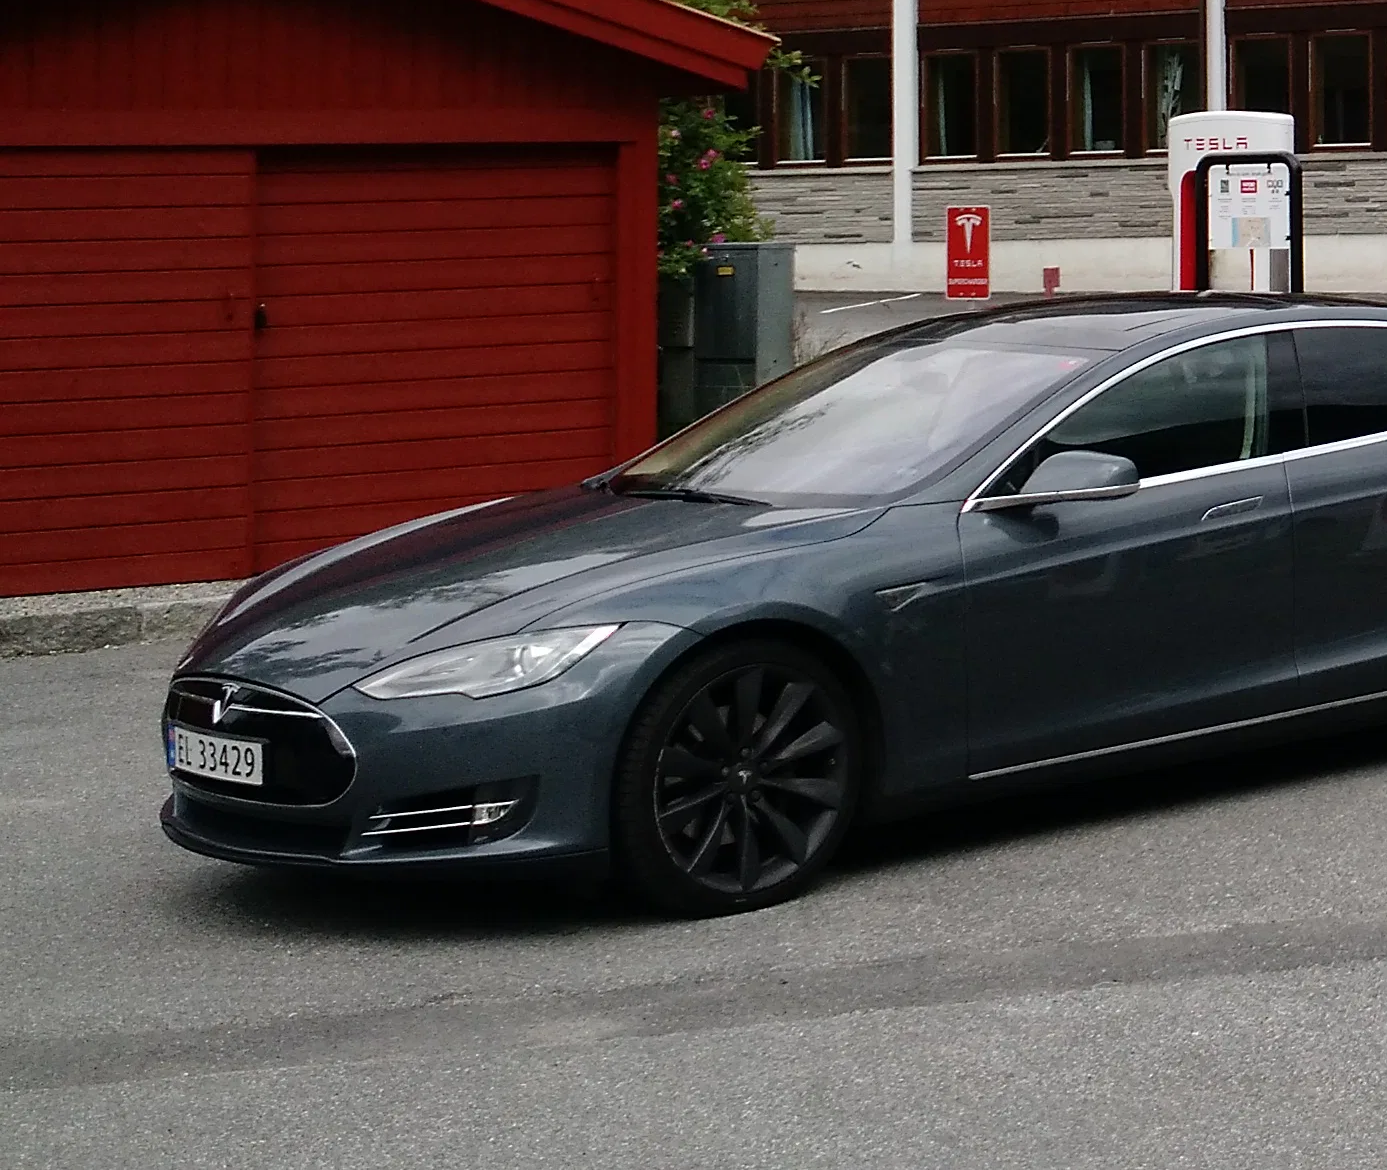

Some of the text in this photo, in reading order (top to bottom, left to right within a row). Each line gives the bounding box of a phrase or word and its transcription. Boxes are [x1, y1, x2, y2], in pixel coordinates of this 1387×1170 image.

[1184, 137, 1248, 151] TESLA
[953, 259, 984, 268] TESLA
[178, 734, 255, 778] EL 33429
